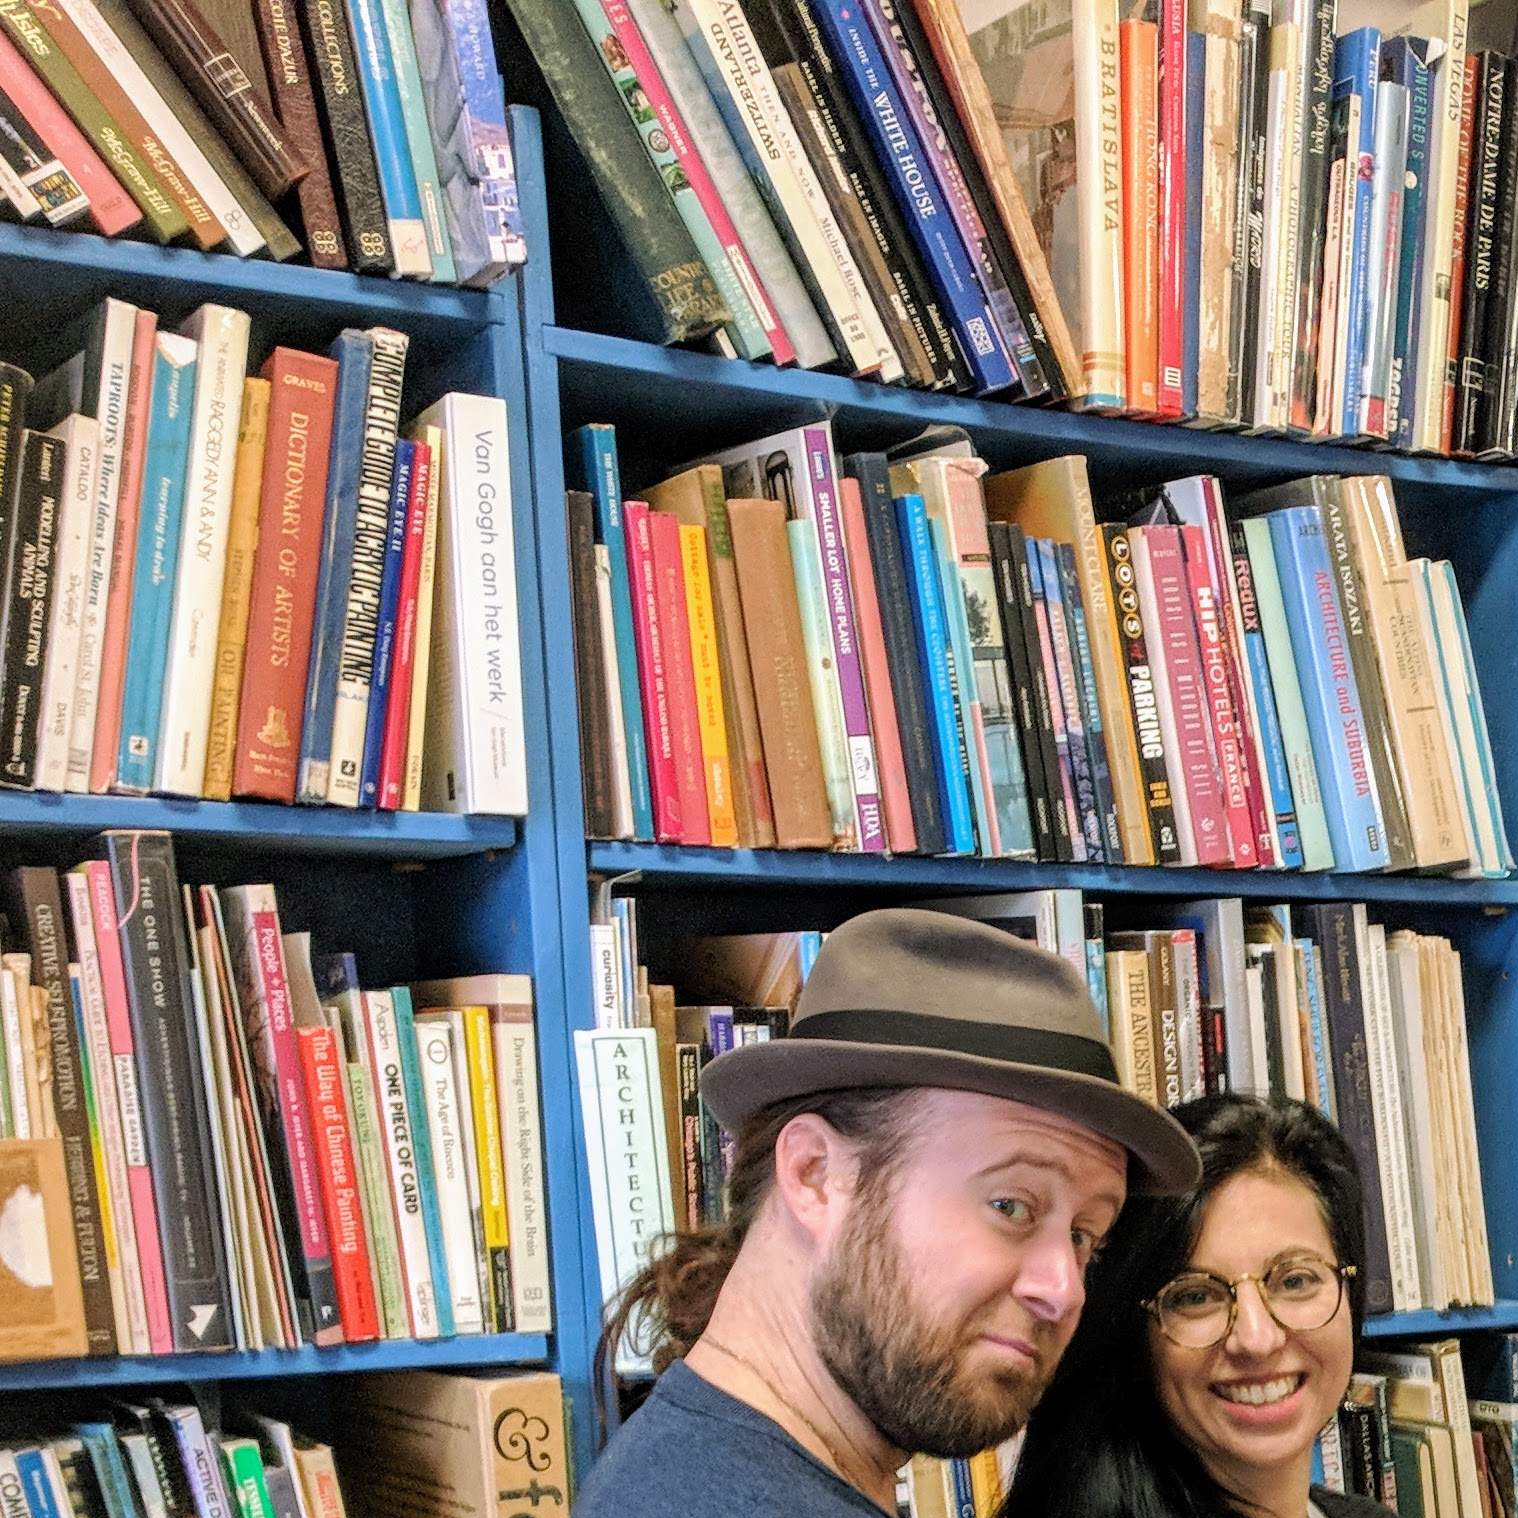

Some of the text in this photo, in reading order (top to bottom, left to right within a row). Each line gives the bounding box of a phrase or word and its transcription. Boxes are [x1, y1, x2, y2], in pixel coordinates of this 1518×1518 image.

[8, 8, 54, 60] Isles
[313, 0, 351, 96] COLLECTIONS
[714, 0, 766, 77] Atlanta
[846, 27, 880, 90] INSIDE THE
[1446, 13, 1466, 122] LAS VEGAS
[706, 21, 783, 162] SWITZERLAND
[242, 99, 284, 153] Newsweek
[657, 104, 688, 155] WAGNER
[868, 91, 938, 220] WHITE HOUSE
[1099, 38, 1118, 232] BRATISLAVA
[97, 123, 172, 220] McGraw-Hill
[138, 133, 211, 227] McGraw-Hill
[1141, 120, 1157, 236] HONG KONG
[1473, 67, 1505, 290] NOTRE-DAME DE PARIS
[76, 447, 90, 501] CATALDO
[87, 362, 124, 607] TAPROOTS: Where Ideas Are Born
[153, 475, 171, 535] learning
[278, 411, 308, 541] DICTIONARY
[394, 463, 407, 506] MAGIC
[411, 465, 427, 535] MAGIC EYE
[152, 536, 166, 549] to
[340, 341, 404, 688] COMPLETE GUIDE TO ACRYLIC PAINTING
[19, 542, 36, 599] ANIMALS
[25, 494, 54, 667] MODELLING AND SCULPTING
[275, 548, 297, 580] OF
[473, 430, 508, 704] Van Gogh aan het werk
[817, 491, 851, 655] SMALLER LOT HOME PLANS
[1071, 485, 1106, 614] MOUNT CLARE
[1326, 502, 1362, 636] ARATA ISOZAKI
[268, 586, 295, 670] ARTISTS
[917, 550, 935, 608] THROUGH
[929, 633, 947, 692] CLOISTERS
[1232, 557, 1259, 631] Redux
[1195, 586, 1234, 734] HIP HOTELS
[1312, 569, 1371, 797] ARCHITECTURE and SUBURBIA
[1127, 664, 1164, 759] PARKING
[1221, 743, 1242, 803] FRANCE
[135, 876, 167, 1009] THE ONE SHOW
[257, 926, 281, 974] People
[266, 987, 290, 1033] Places
[601, 949, 614, 1010] curiosity
[1127, 970, 1146, 1008] THE
[508, 1037, 526, 1078] Drawing
[1160, 1010, 1177, 1071] DESIGN
[433, 1078, 448, 1100] The
[435, 1102, 451, 1125] Age
[512, 1082, 528, 1102] on
[513, 1106, 530, 1125] the
[308, 1033, 363, 1254] The Way of Chinese Painting
[382, 1063, 419, 1215] ONE PIECE OF CARD
[440, 1139, 458, 1180] Rococo
[515, 1128, 532, 1159] Right
[518, 1163, 534, 1188] Side
[521, 1205, 537, 1223] the
[522, 1226, 539, 1257] Brain
[492, 1406, 552, 1472] &
[191, 1446, 219, 1506] ACTIVE
